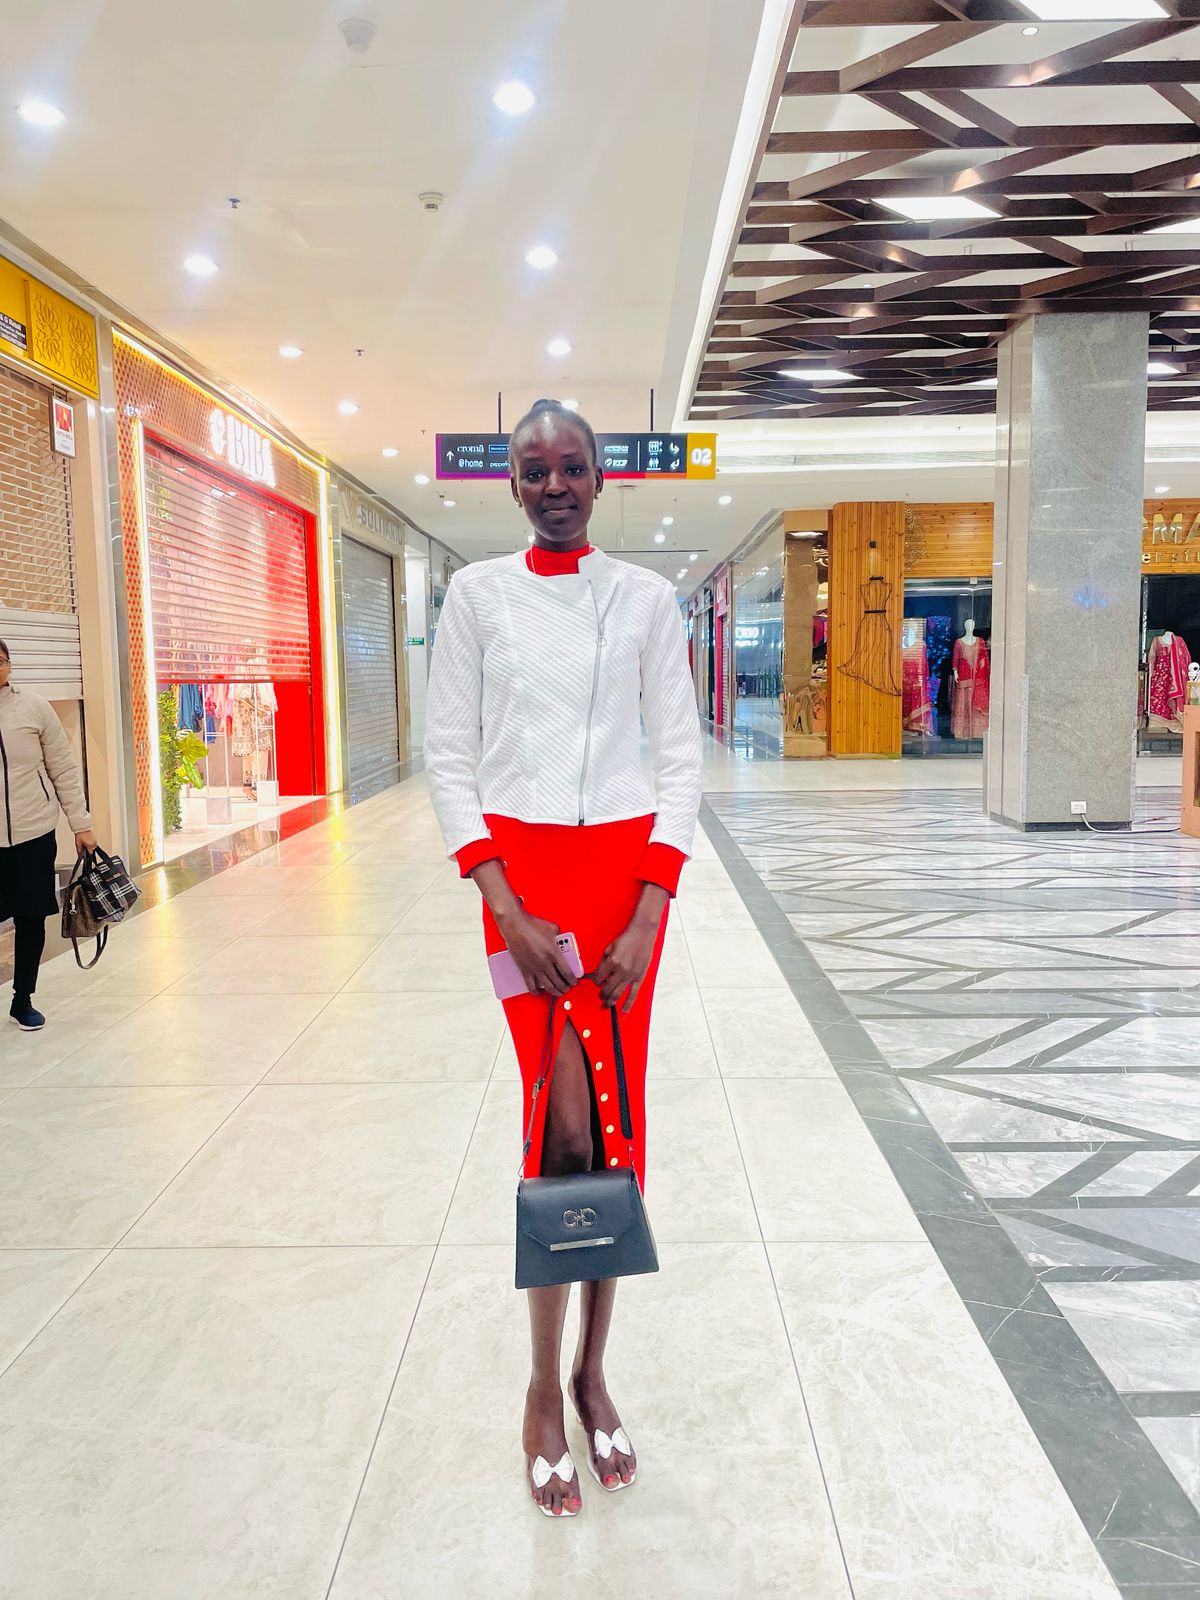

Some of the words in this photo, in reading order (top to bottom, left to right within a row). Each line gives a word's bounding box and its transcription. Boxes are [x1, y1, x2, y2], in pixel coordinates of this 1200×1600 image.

[226, 415, 276, 488] BIBA
[691, 448, 712, 466] 02
[458, 458, 484, 467] @home
